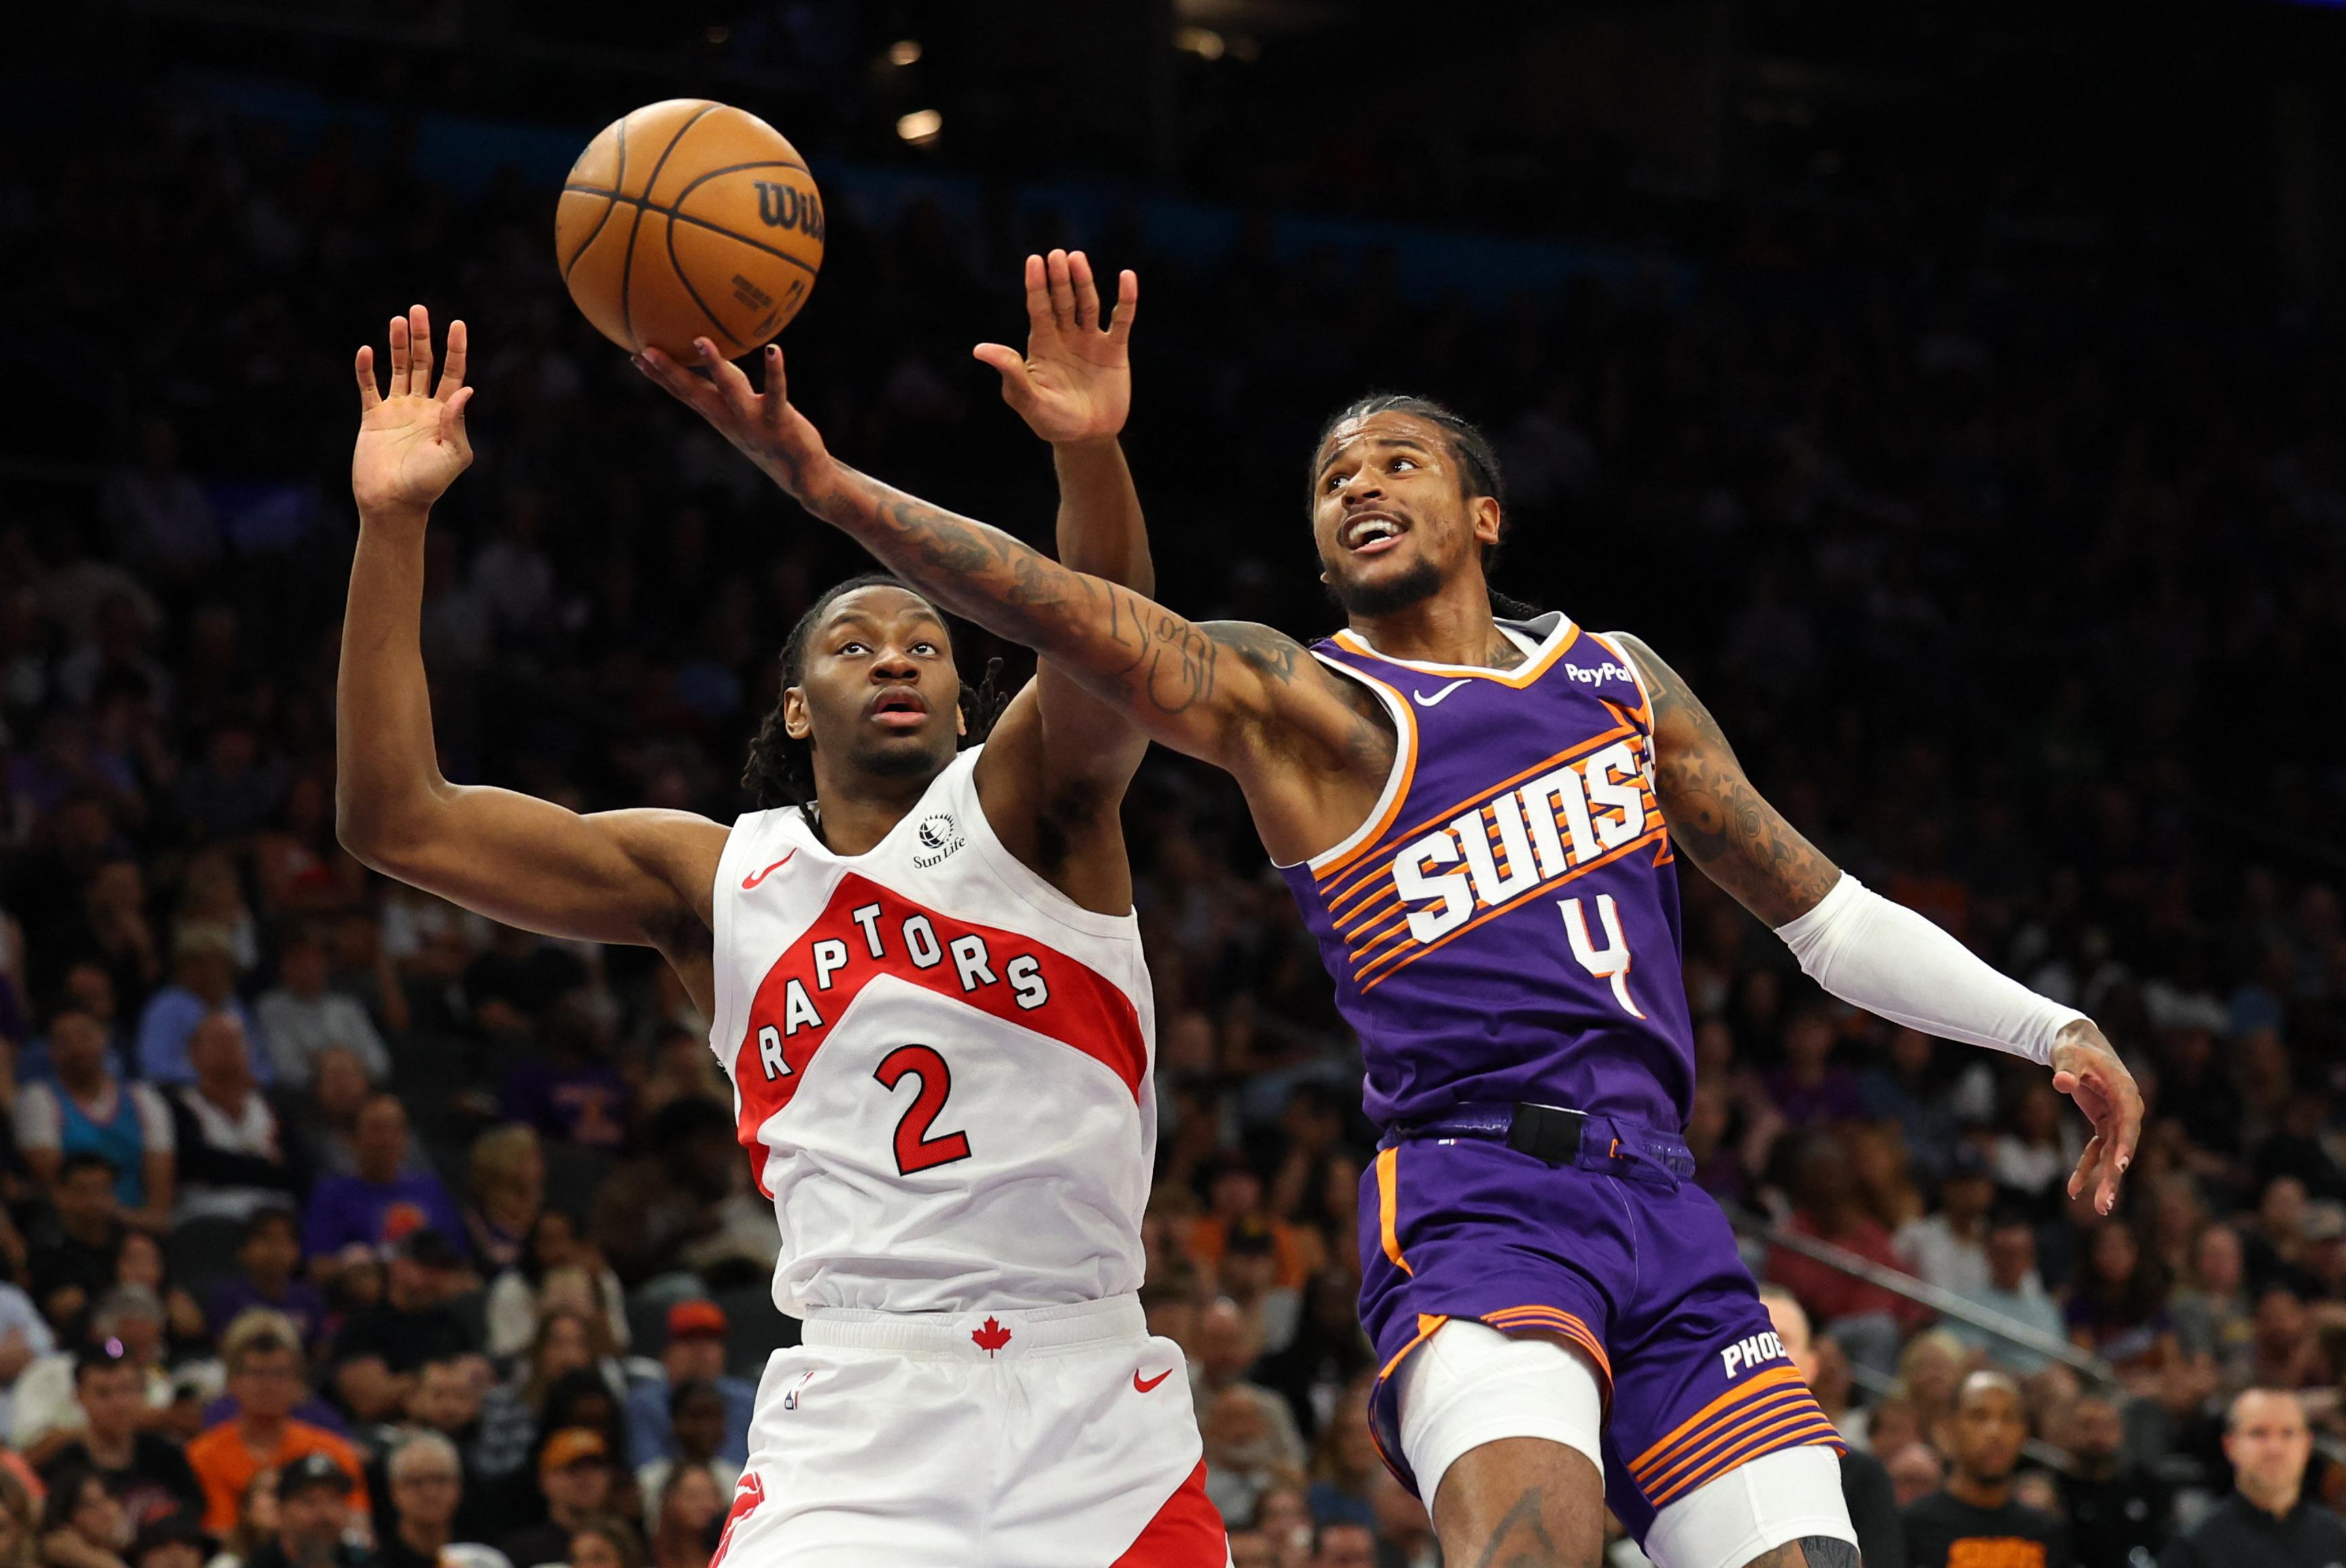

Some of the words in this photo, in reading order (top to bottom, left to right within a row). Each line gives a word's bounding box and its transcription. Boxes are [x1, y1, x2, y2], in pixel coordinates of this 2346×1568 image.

[752, 180, 825, 243] Wil
[1565, 662, 1633, 687] PayPal
[913, 856, 942, 869] Sun
[943, 836, 966, 858] Life
[1391, 742, 1646, 944] SUNS
[758, 902, 1049, 1081] RAPTORS
[1557, 893, 1646, 1019] 4
[872, 1043, 972, 1176] 2
